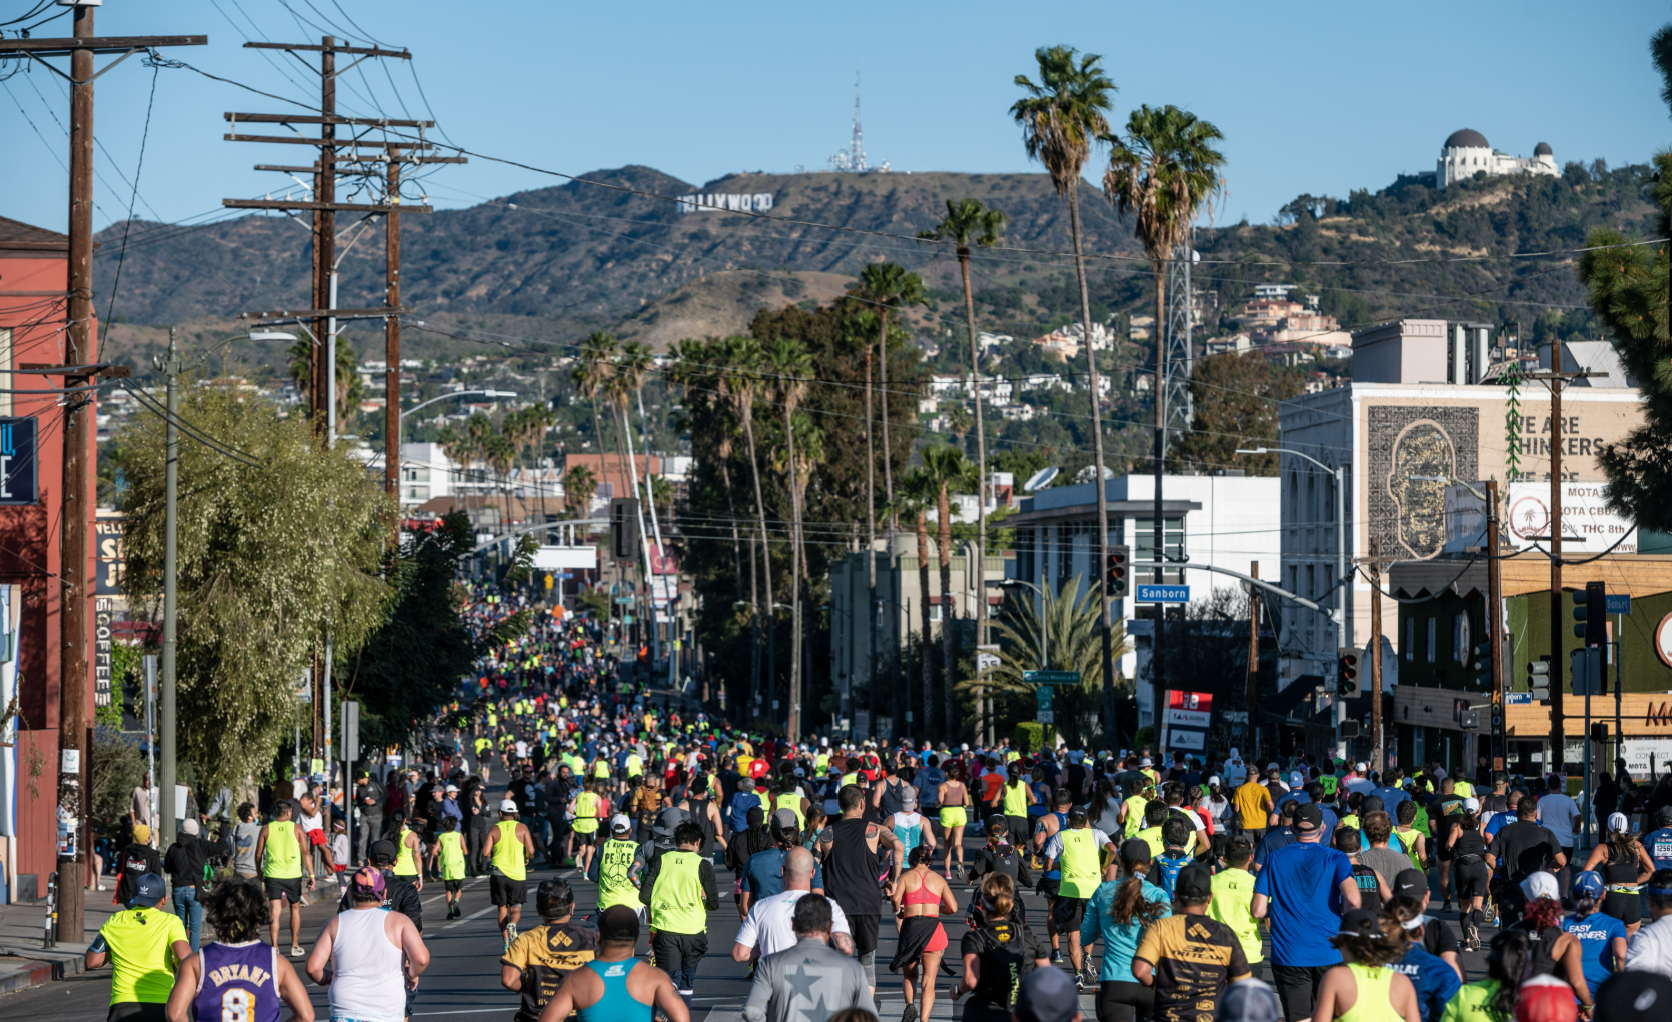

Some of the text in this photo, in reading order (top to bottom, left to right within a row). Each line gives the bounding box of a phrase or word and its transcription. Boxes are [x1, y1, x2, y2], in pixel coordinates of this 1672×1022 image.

[676, 192, 774, 213] HOLLYWOOD
[1541, 416, 1580, 434] ARE
[1568, 487, 1600, 497] MOTA
[1582, 524, 1605, 534] THC
[1608, 524, 1625, 534] 8th
[1142, 588, 1186, 598] Sanborn
[1607, 600, 1628, 609] Sunset
[97, 613, 111, 691] COFFEE
[981, 660, 998, 671] 35
[605, 853, 631, 865] PECE
[1569, 924, 1592, 933] EASY
[208, 964, 271, 987] BRYANT
[1009, 962, 1019, 1005] NATHAN
[222, 988, 256, 1022] 8
